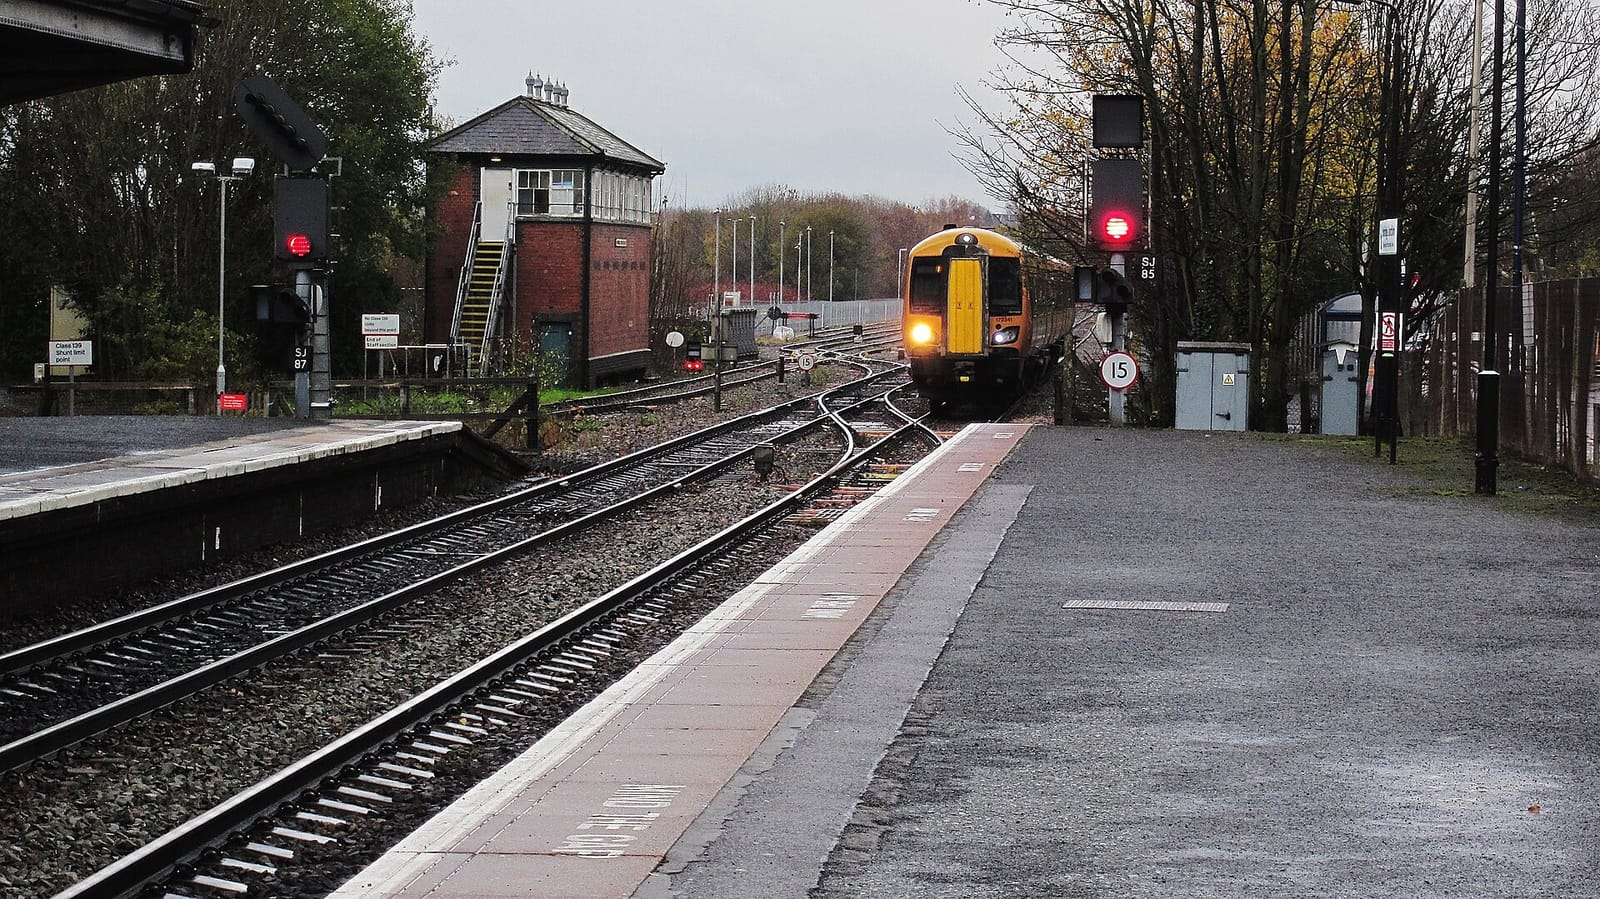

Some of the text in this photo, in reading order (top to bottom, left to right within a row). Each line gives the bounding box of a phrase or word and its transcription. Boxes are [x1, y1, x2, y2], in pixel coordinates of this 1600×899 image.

[1141, 257, 1155, 267] SJ
[1141, 269, 1155, 279] 85
[295, 347, 307, 357] SJ
[294, 359, 307, 369] 87
[803, 358, 811, 367] 15
[1112, 362, 1127, 378] 15
[602, 784, 687, 808] MIND
[575, 813, 661, 831] THE
[551, 834, 638, 859] GAP
